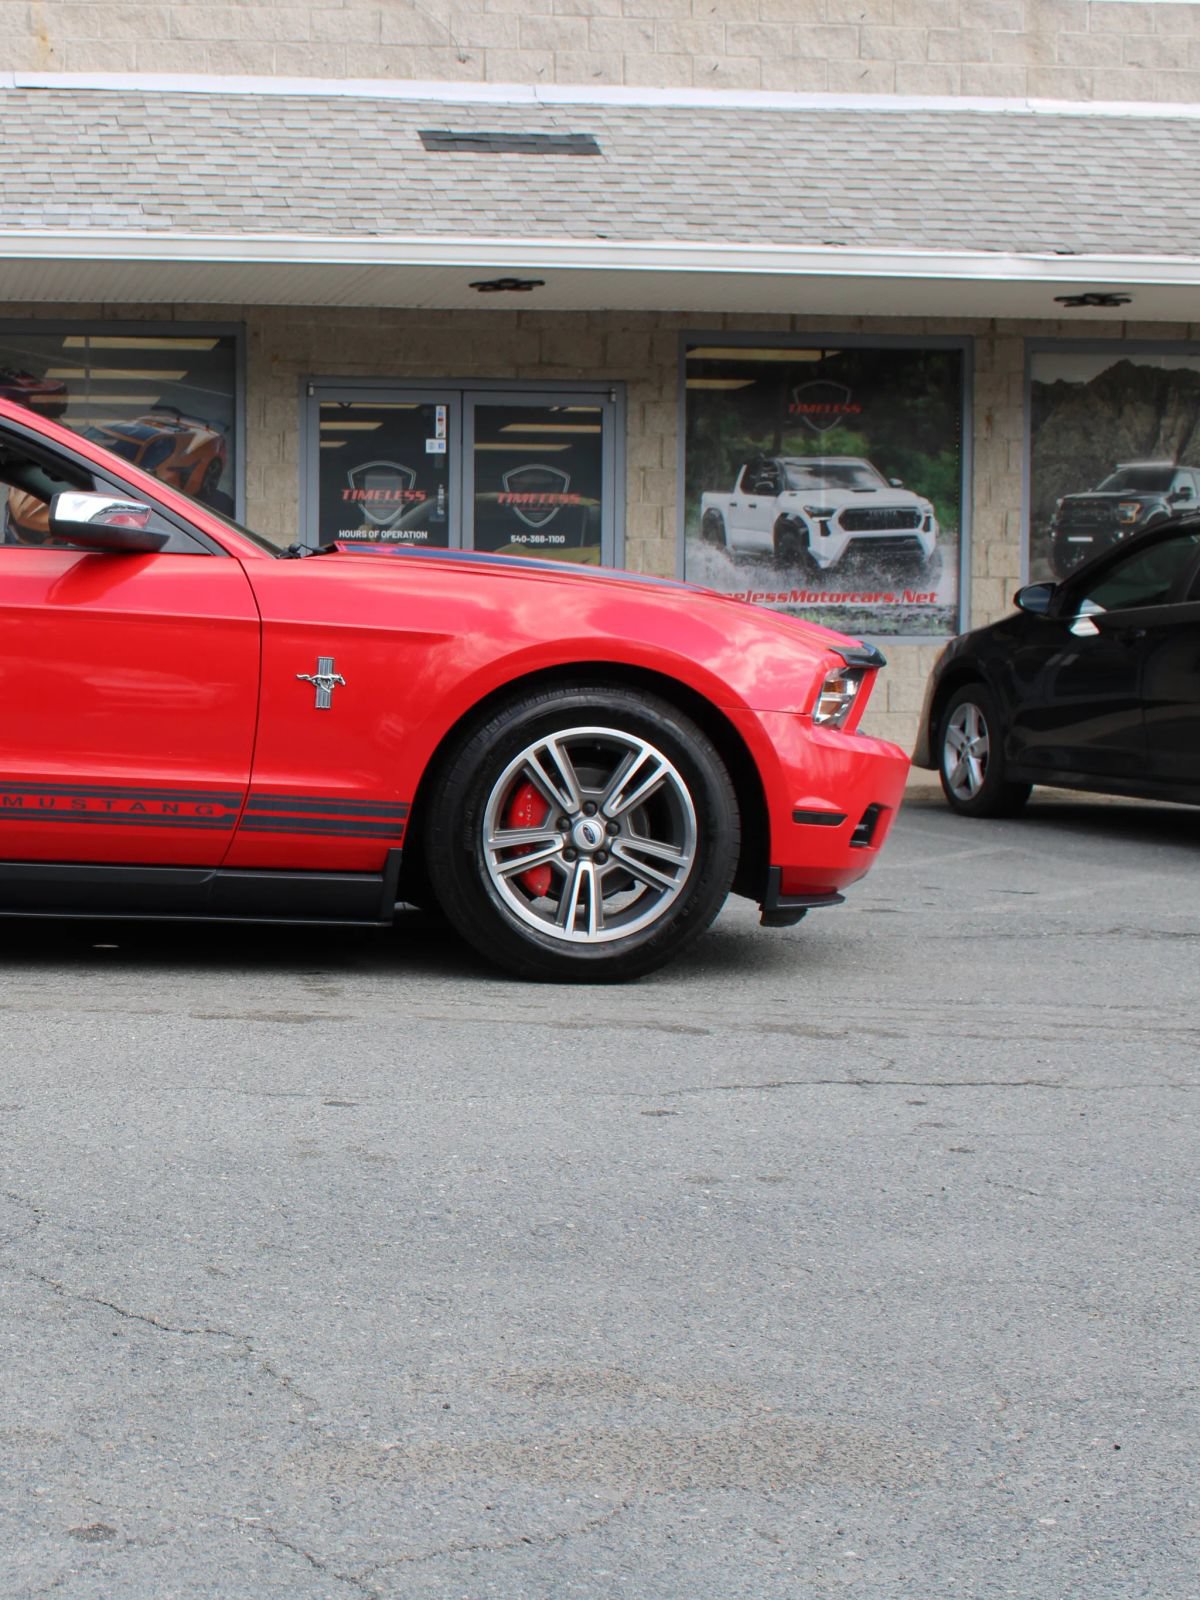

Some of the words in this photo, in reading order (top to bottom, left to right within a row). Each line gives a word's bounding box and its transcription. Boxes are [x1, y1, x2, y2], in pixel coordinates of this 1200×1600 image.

[789, 403, 863, 414] TIMELESS
[342, 489, 427, 501] TIMELESS
[497, 492, 580, 504] TIMELESS
[339, 530, 367, 538] HOURS
[368, 530, 379, 538] OF
[381, 530, 428, 539] OPERATION
[726, 590, 937, 604] elessMotorcars.Net
[2, 796, 214, 815] MUSTANG
